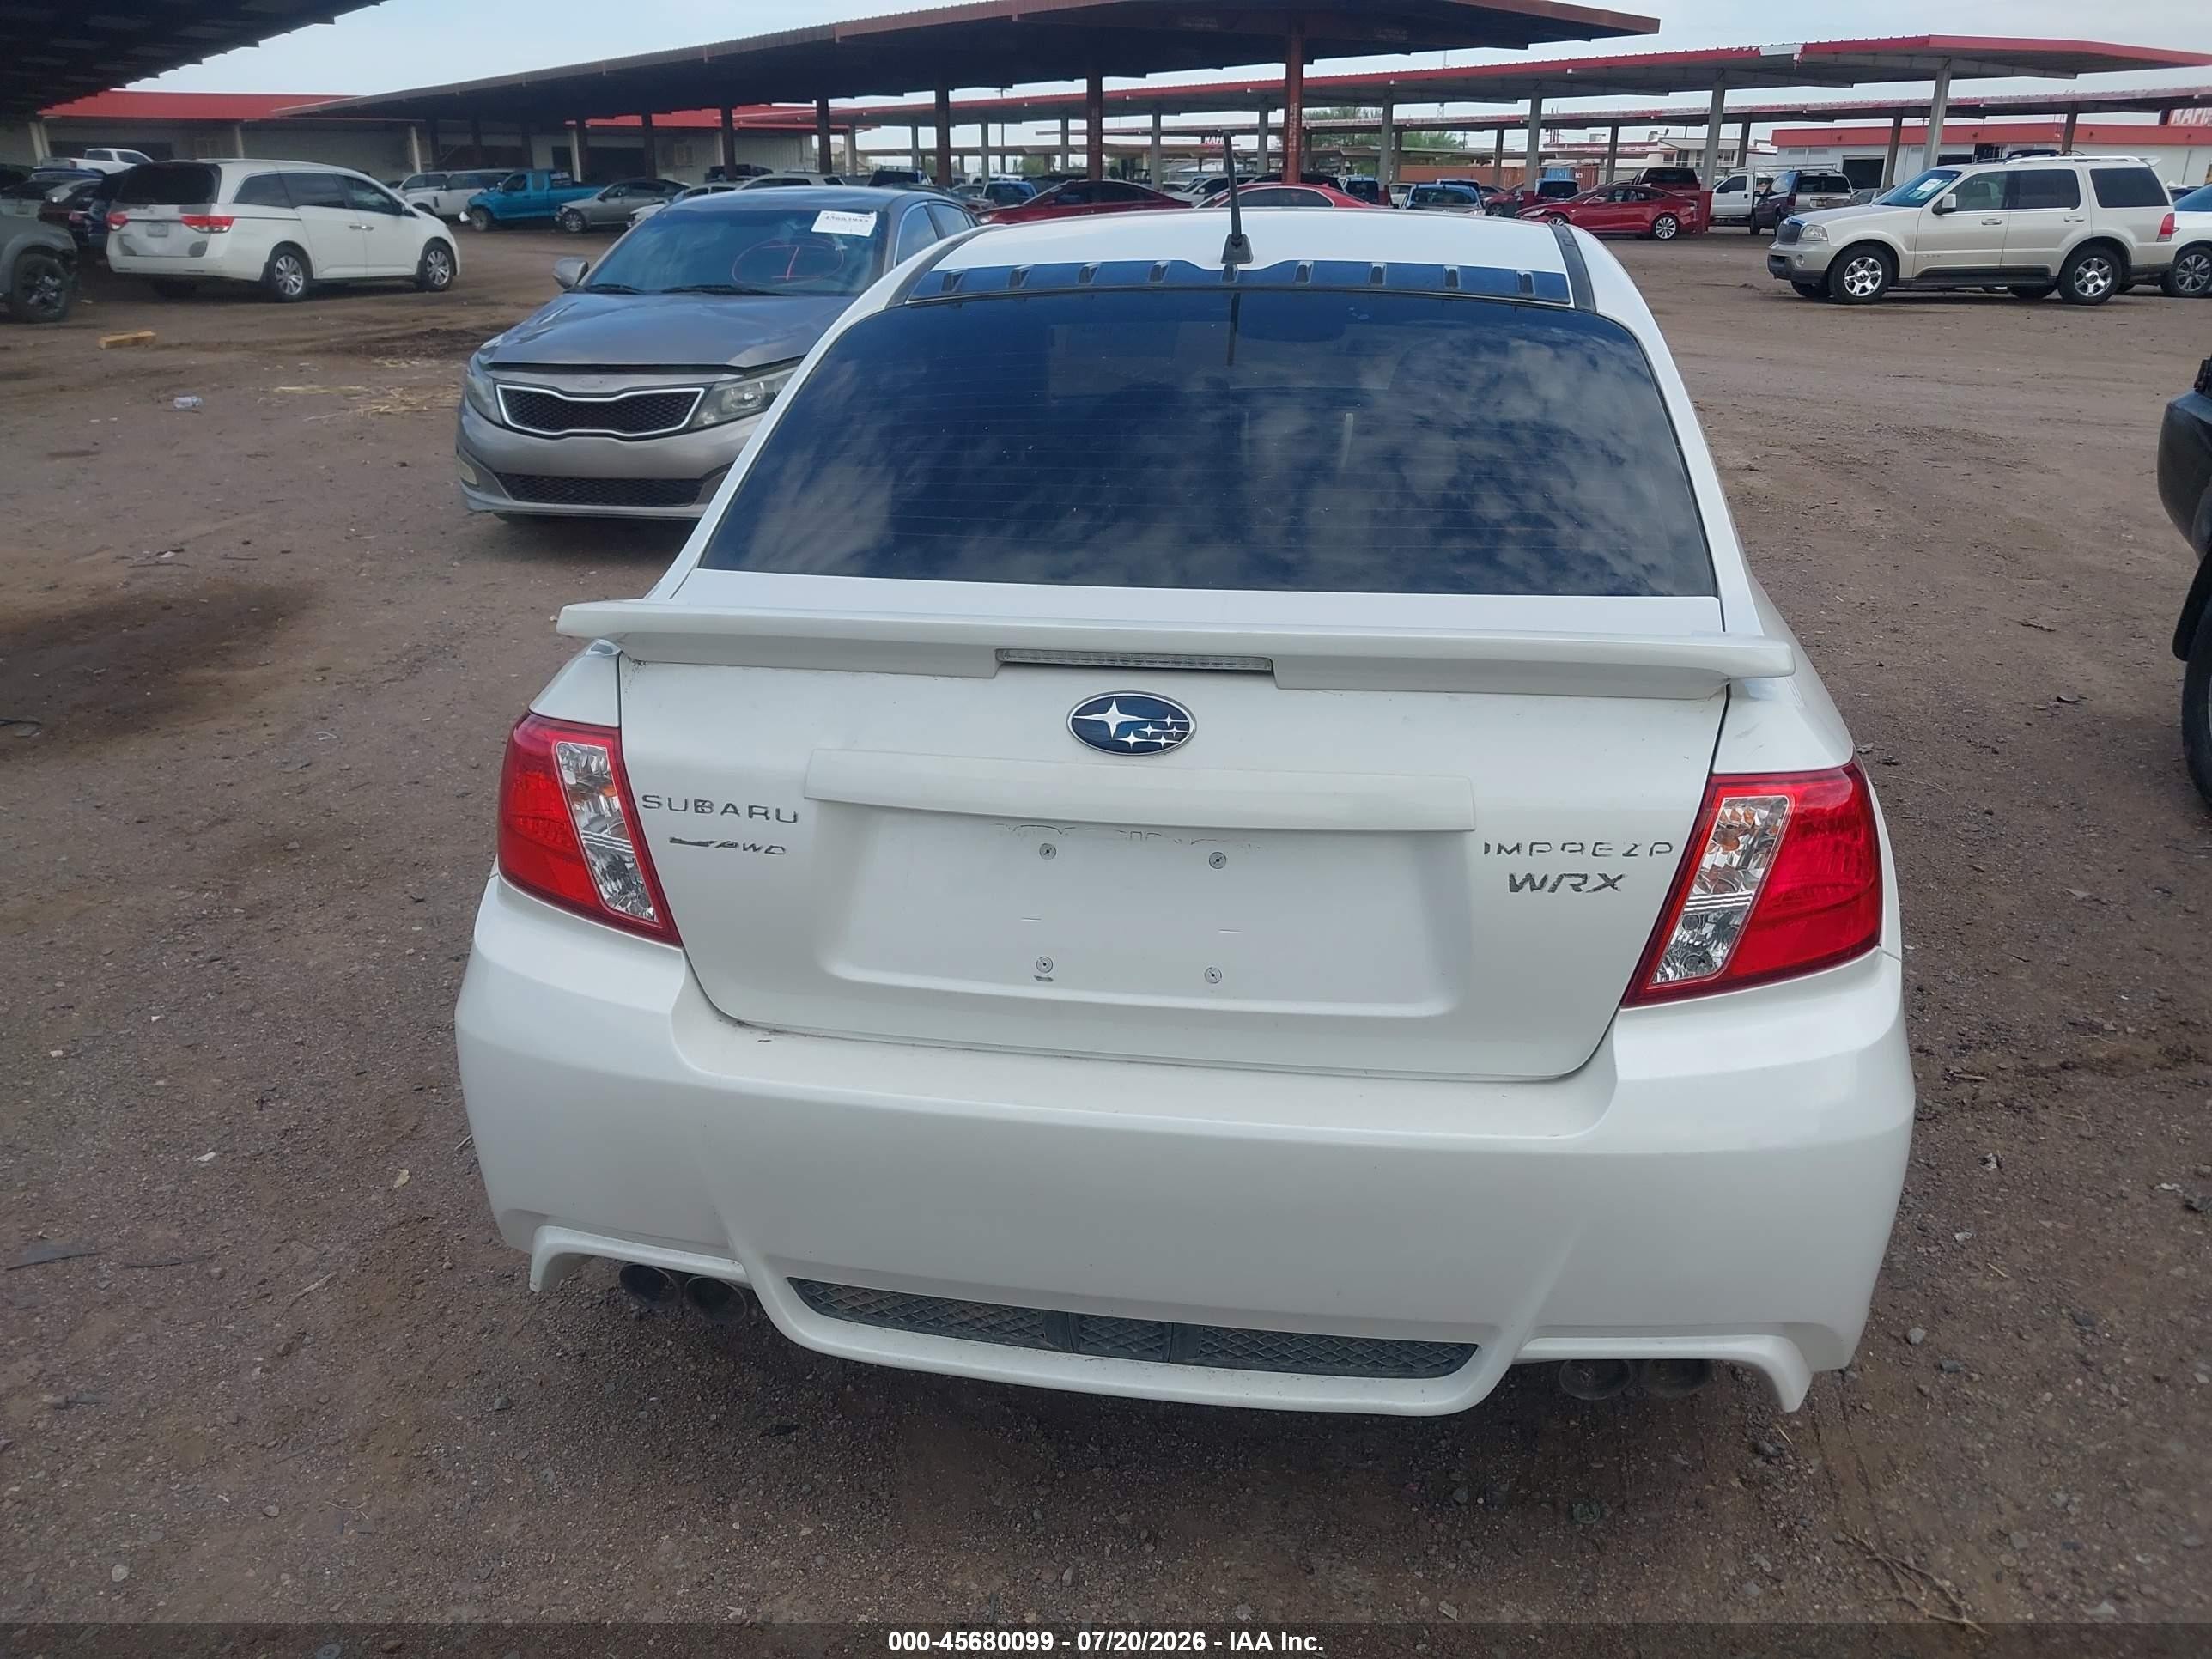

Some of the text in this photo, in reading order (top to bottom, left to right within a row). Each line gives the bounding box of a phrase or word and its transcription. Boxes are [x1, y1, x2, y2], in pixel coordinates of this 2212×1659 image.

[641, 794, 799, 823] SUBARU
[714, 840, 787, 856] AWD
[1508, 872, 1626, 894] WRX
